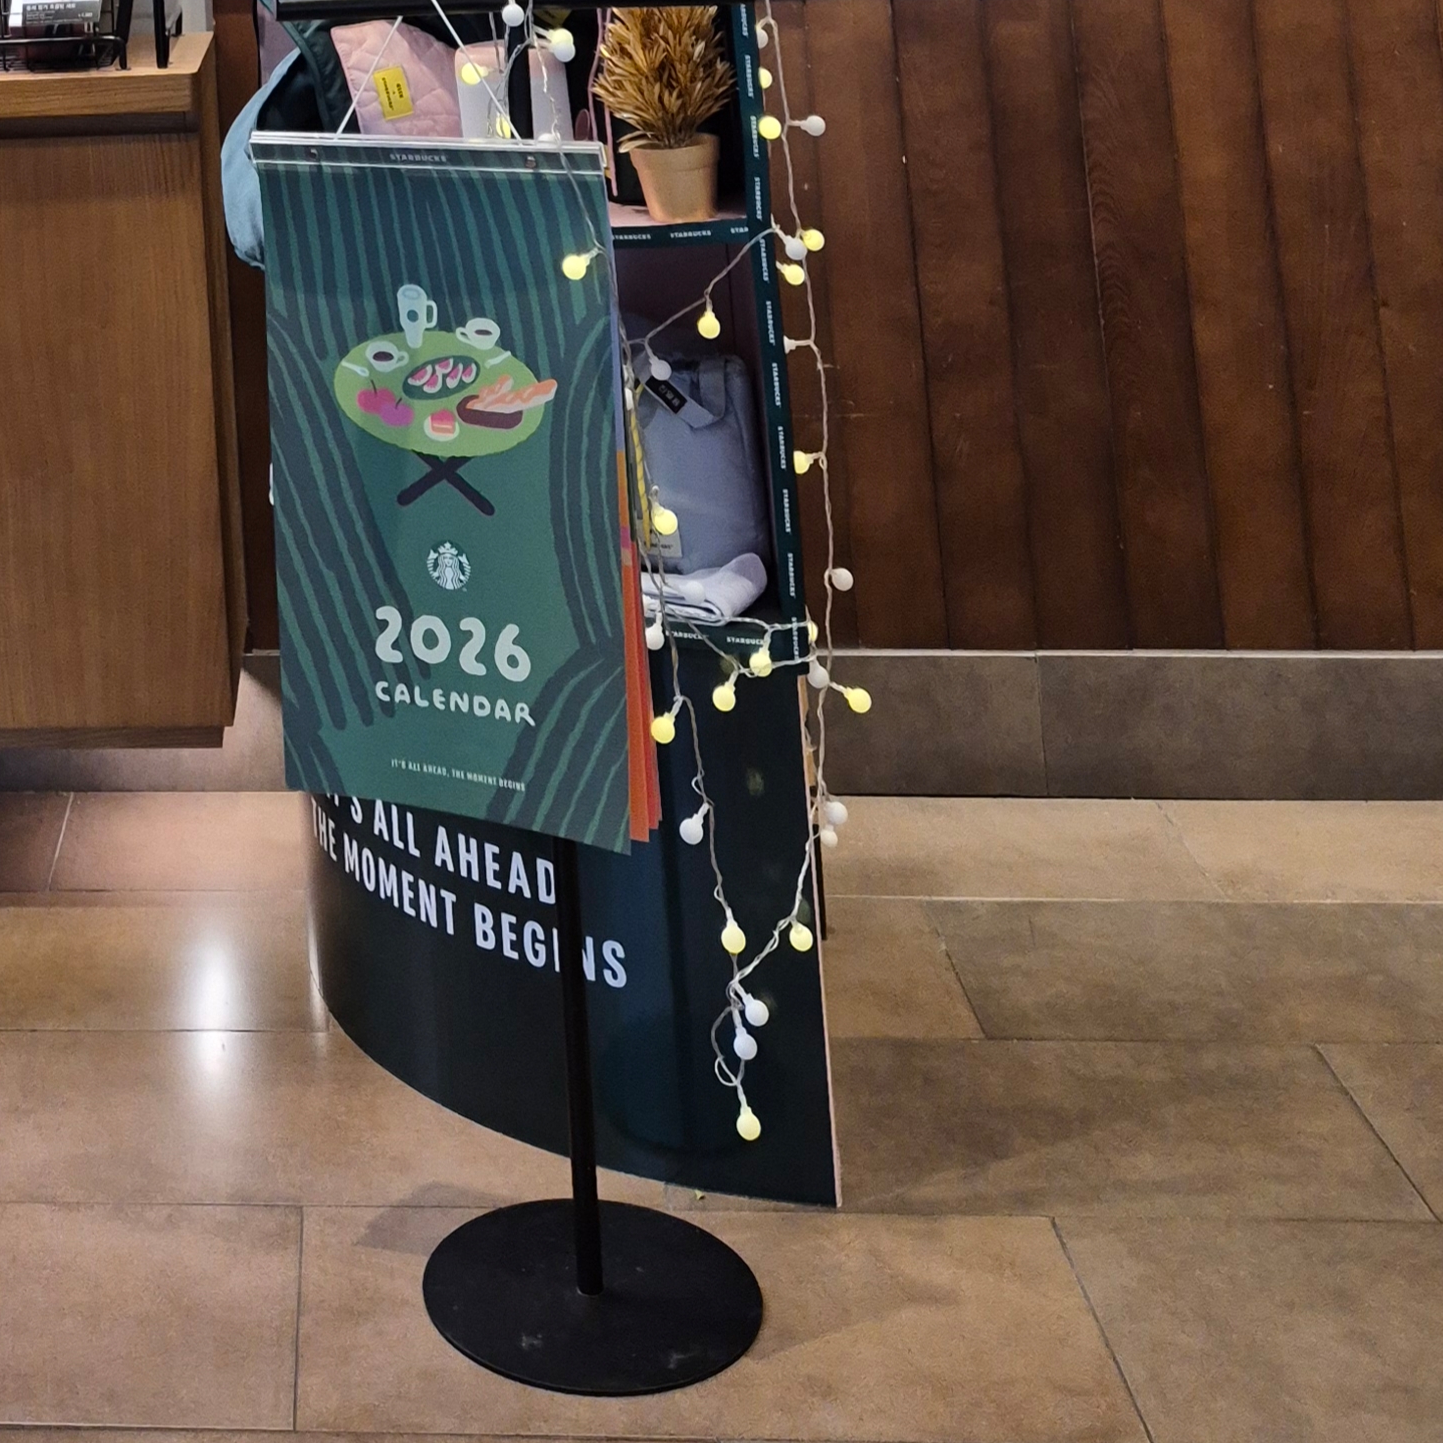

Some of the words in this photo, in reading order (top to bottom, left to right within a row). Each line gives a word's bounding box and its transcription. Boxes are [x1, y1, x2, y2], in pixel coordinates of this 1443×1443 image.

[389, 153, 447, 162] STARBUCKS
[754, 176, 763, 221] STARBUCKS
[670, 230, 711, 238] STARBUCKS
[766, 300, 776, 346] STARBUCKS
[772, 362, 782, 407] STARBUCKS
[778, 426, 787, 470] STARBUCKS
[782, 489, 792, 534] STARBUCKS
[787, 553, 796, 598] STARBUCKS
[375, 605, 531, 682] 2026
[375, 681, 536, 727] CALENDAR
[408, 761, 421, 772] ALL
[423, 763, 450, 778] AHEAD,
[452, 768, 465, 780] THE
[466, 772, 497, 786] MOMENT
[498, 777, 526, 792] BEGINS
[373, 799, 421, 858] ALL
[434, 825, 556, 905] AHEAD
[311, 795, 337, 862] THE
[343, 831, 457, 936] MOMENT
[474, 902, 627, 988] BEGINS
